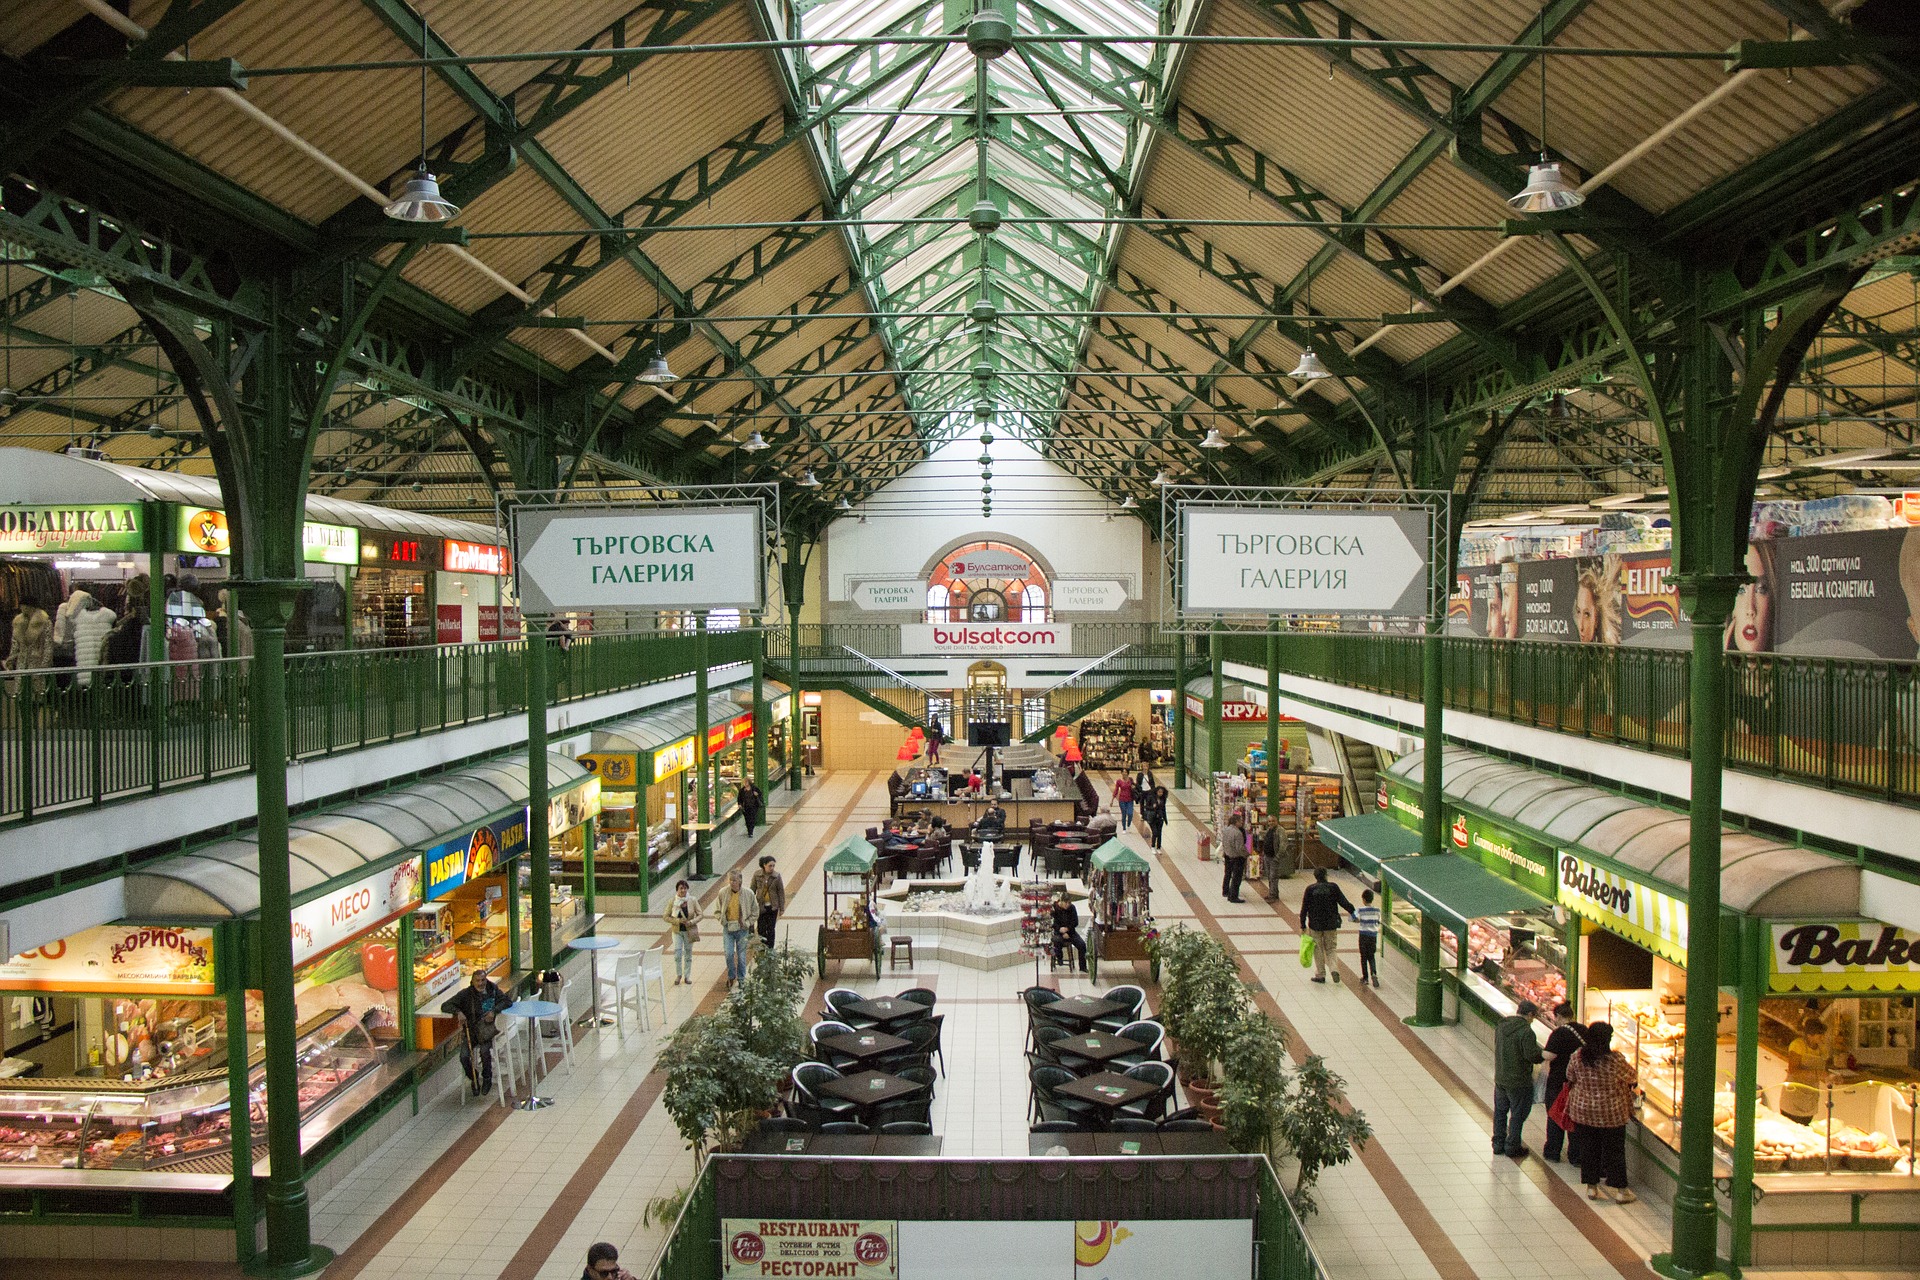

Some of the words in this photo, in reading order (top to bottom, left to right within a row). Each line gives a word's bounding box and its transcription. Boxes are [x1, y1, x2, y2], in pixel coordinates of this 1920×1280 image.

[391, 540, 418, 562] ART
[572, 534, 715, 556] ТЪРГОВСКА
[1217, 533, 1365, 556] ТЪРГОВСКА
[591, 563, 694, 584] ГАЛЕРИЯ
[967, 562, 1027, 572] Булсатком
[1806, 555, 1820, 573] 300
[1821, 556, 1860, 576] артикула
[1240, 567, 1347, 590] ГАЛЕРИЯ
[1539, 578, 1554, 594] 1000
[868, 587, 914, 595] ТЪРГОВСКА
[1062, 586, 1109, 595] ТЪРГОВСКА
[1825, 579, 1875, 598] КОЗМЕТИКА
[874, 596, 908, 604] ГАЛЕРИЯ
[1069, 597, 1104, 605] ГАЛЕРИЯ
[1632, 621, 1650, 629] MEGA
[1651, 621, 1674, 629] STORE
[933, 627, 1055, 645] bulsatcom
[331, 888, 371, 927] МЕСО
[125, 930, 192, 954] ОРИОН
[759, 1222, 860, 1237] RESTAURANT
[760, 1261, 859, 1277] РЕСТОРАНТ
